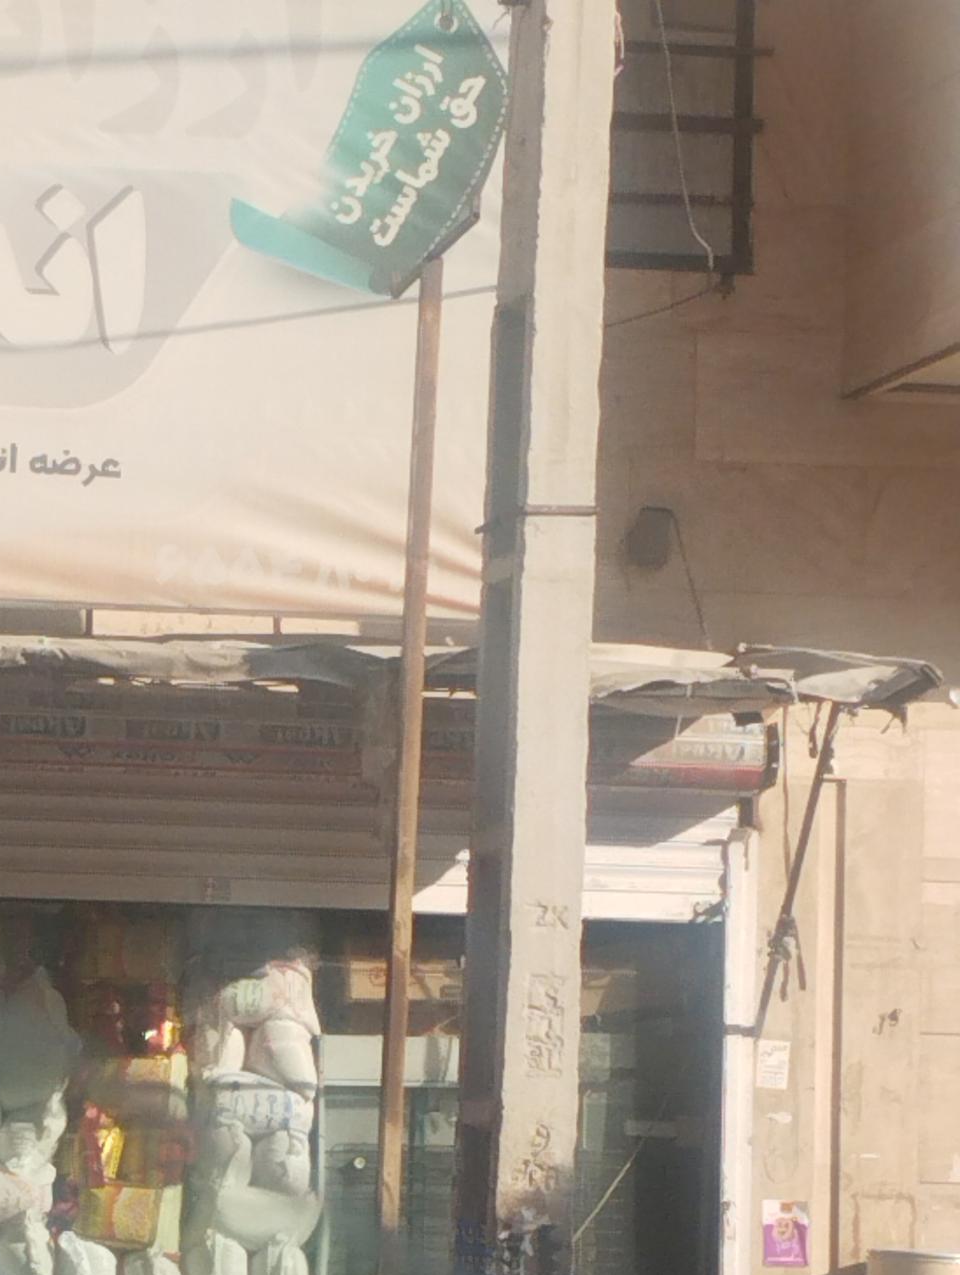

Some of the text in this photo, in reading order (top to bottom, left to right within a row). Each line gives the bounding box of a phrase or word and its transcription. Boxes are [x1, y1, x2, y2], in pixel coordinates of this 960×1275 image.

[330, 44, 444, 225] ارزان خریدن
[369, 75, 487, 247] حق شماست
[29, 450, 122, 486] عرضه
